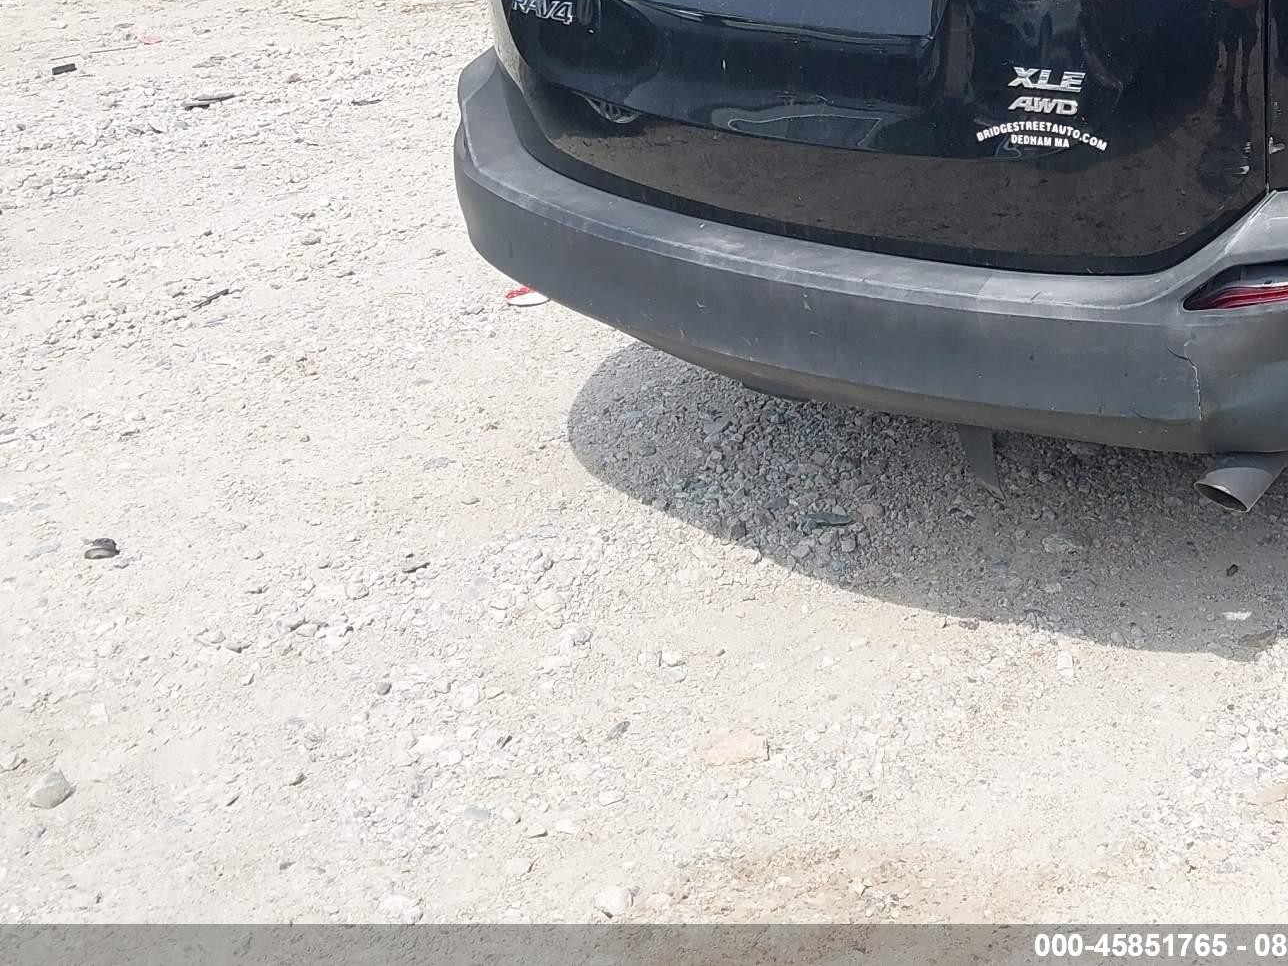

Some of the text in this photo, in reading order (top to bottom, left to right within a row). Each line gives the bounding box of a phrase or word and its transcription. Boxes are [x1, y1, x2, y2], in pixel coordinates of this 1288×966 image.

[1008, 66, 1086, 93] XLE
[1008, 96, 1079, 115] AWD
[976, 121, 1107, 151] BRIDGESTREETAUTO.COM
[1011, 134, 1070, 148] DEDHAM MA
